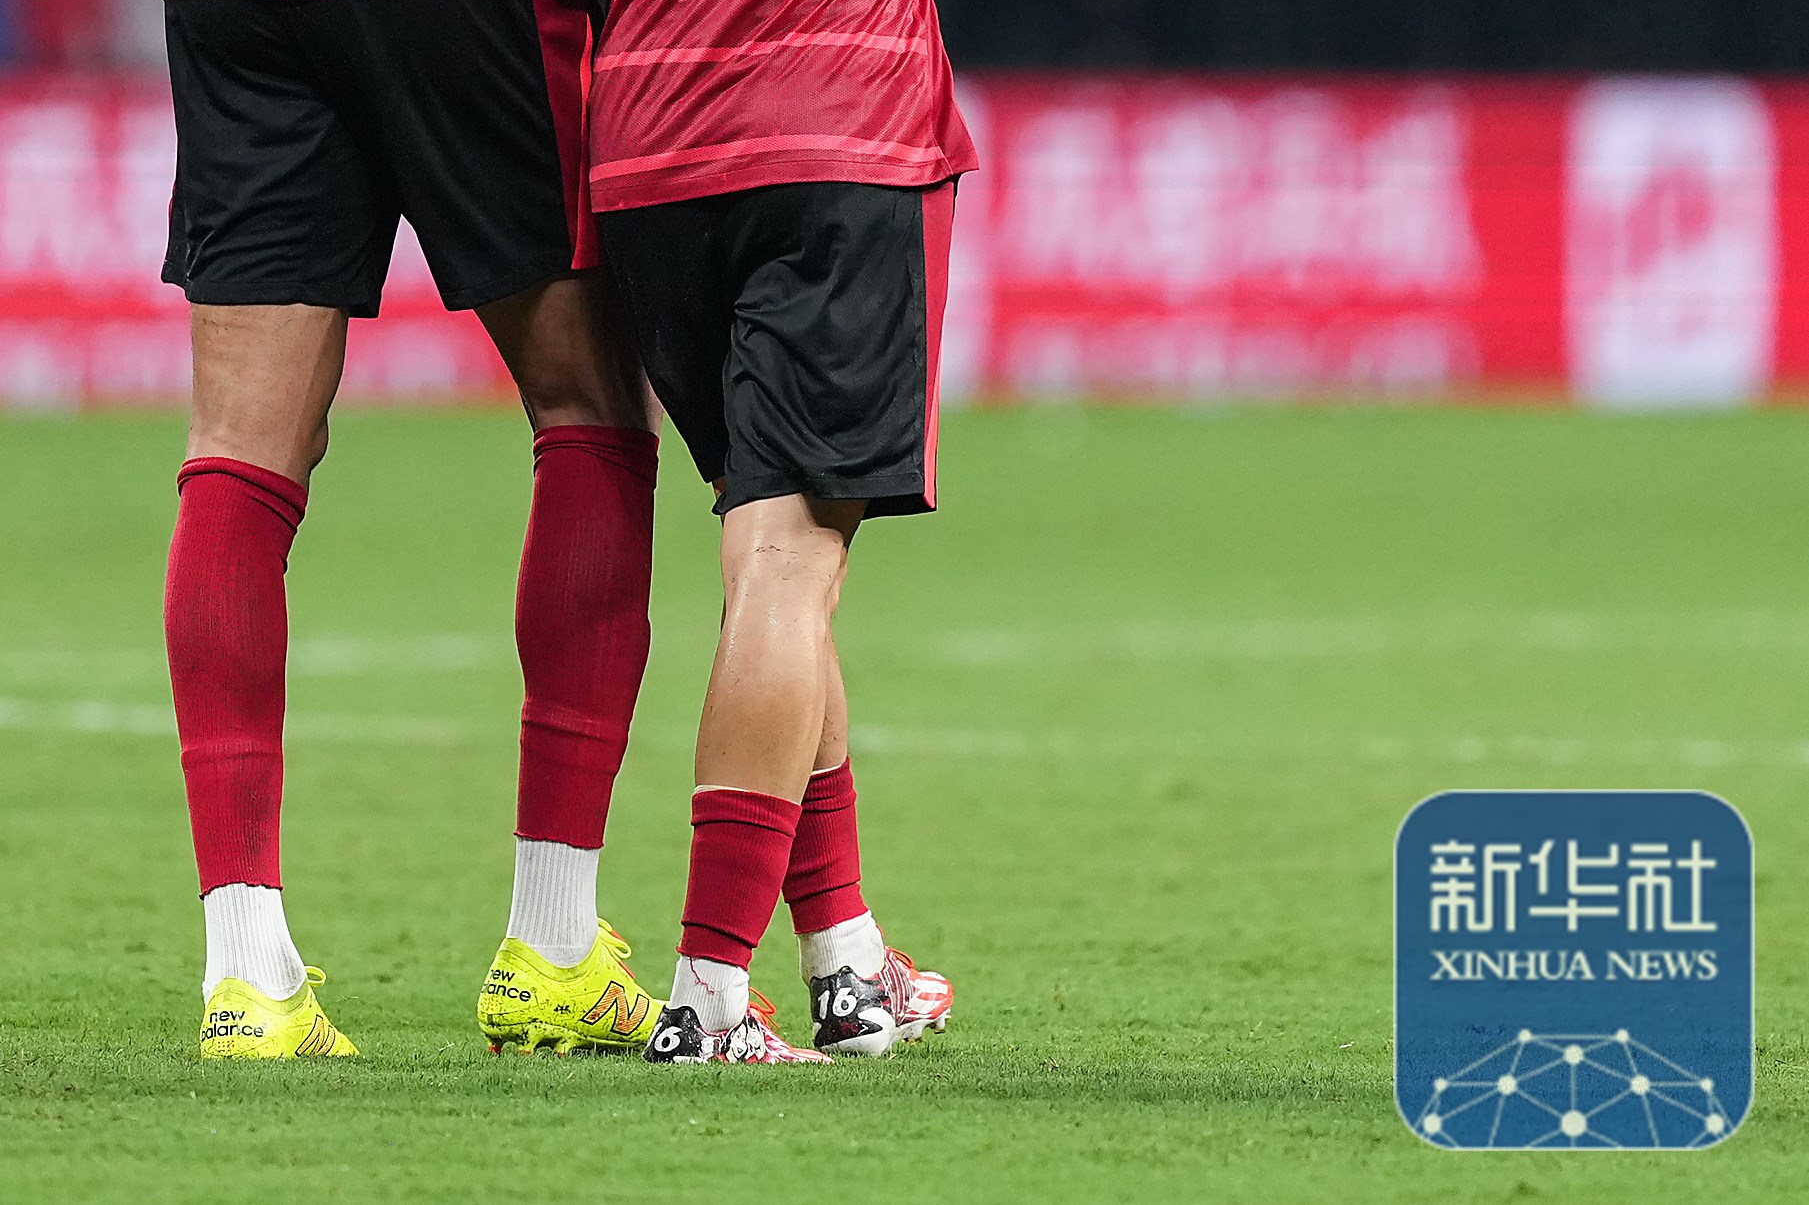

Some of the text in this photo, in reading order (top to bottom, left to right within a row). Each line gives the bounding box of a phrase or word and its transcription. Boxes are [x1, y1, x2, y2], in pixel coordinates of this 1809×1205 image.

[490, 968, 515, 982] ew
[580, 980, 649, 1036] N
[817, 986, 857, 1020] 16
[209, 1010, 245, 1024] new
